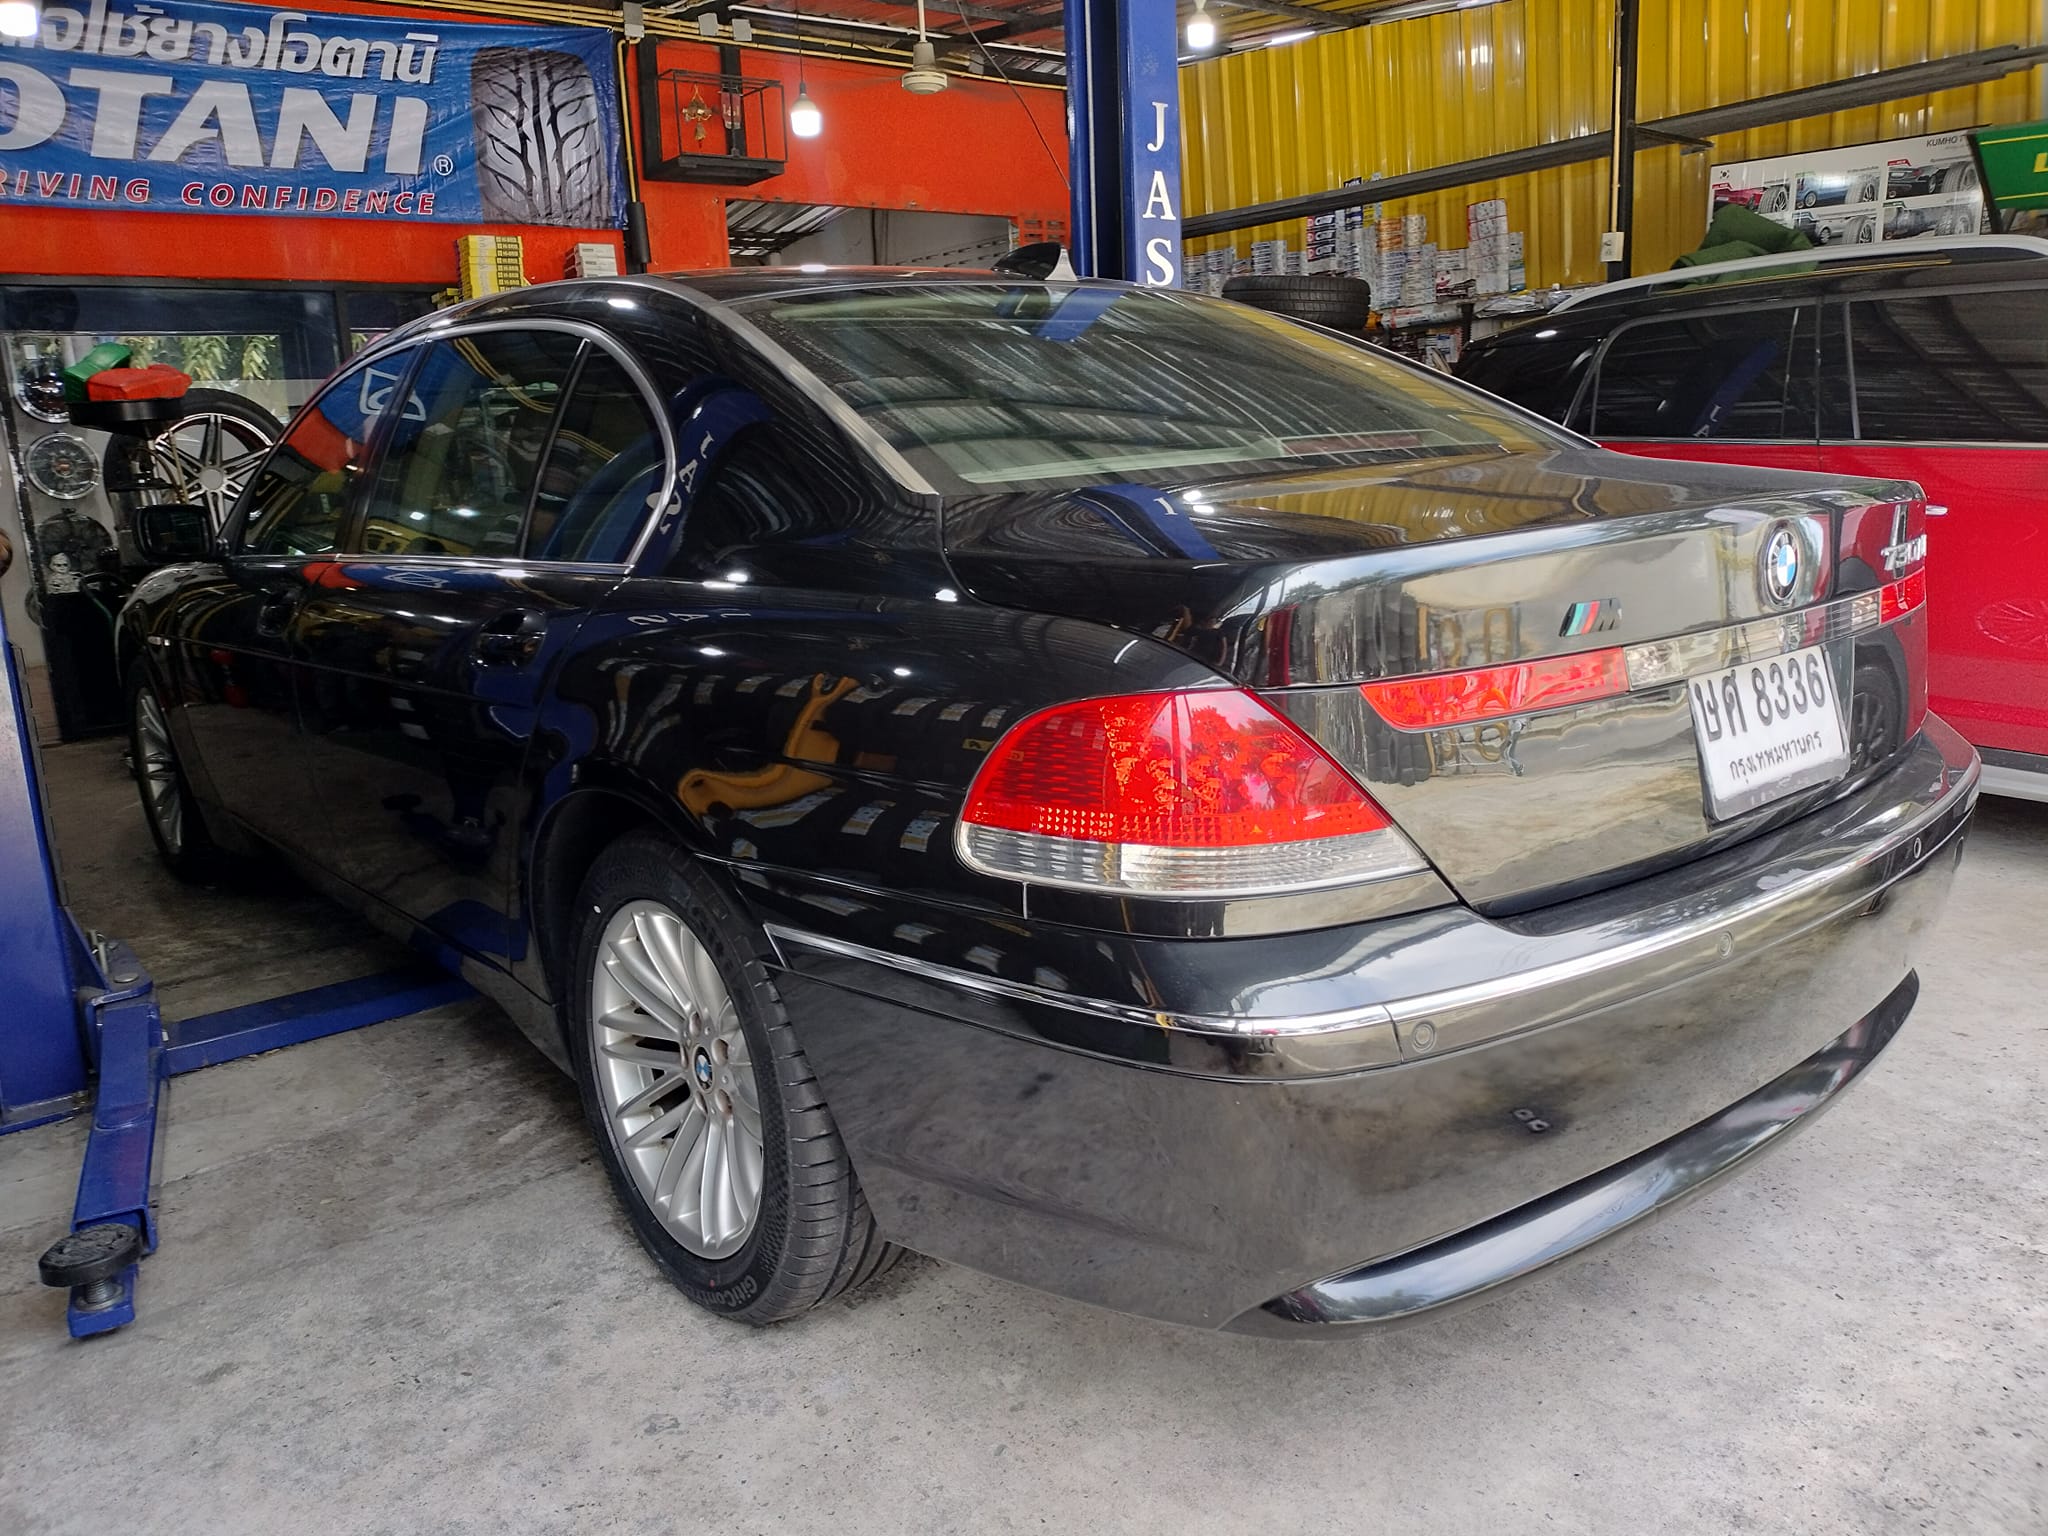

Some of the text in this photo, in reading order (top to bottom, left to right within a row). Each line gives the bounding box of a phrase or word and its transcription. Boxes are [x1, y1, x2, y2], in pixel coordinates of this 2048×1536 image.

[1926, 135, 1958, 147] KUMHO
[181, 181, 435, 216] CONFIDENCE
[1750, 652, 1826, 727] 8336
[1729, 731, 1823, 783] กรุงเทพมหานคร
